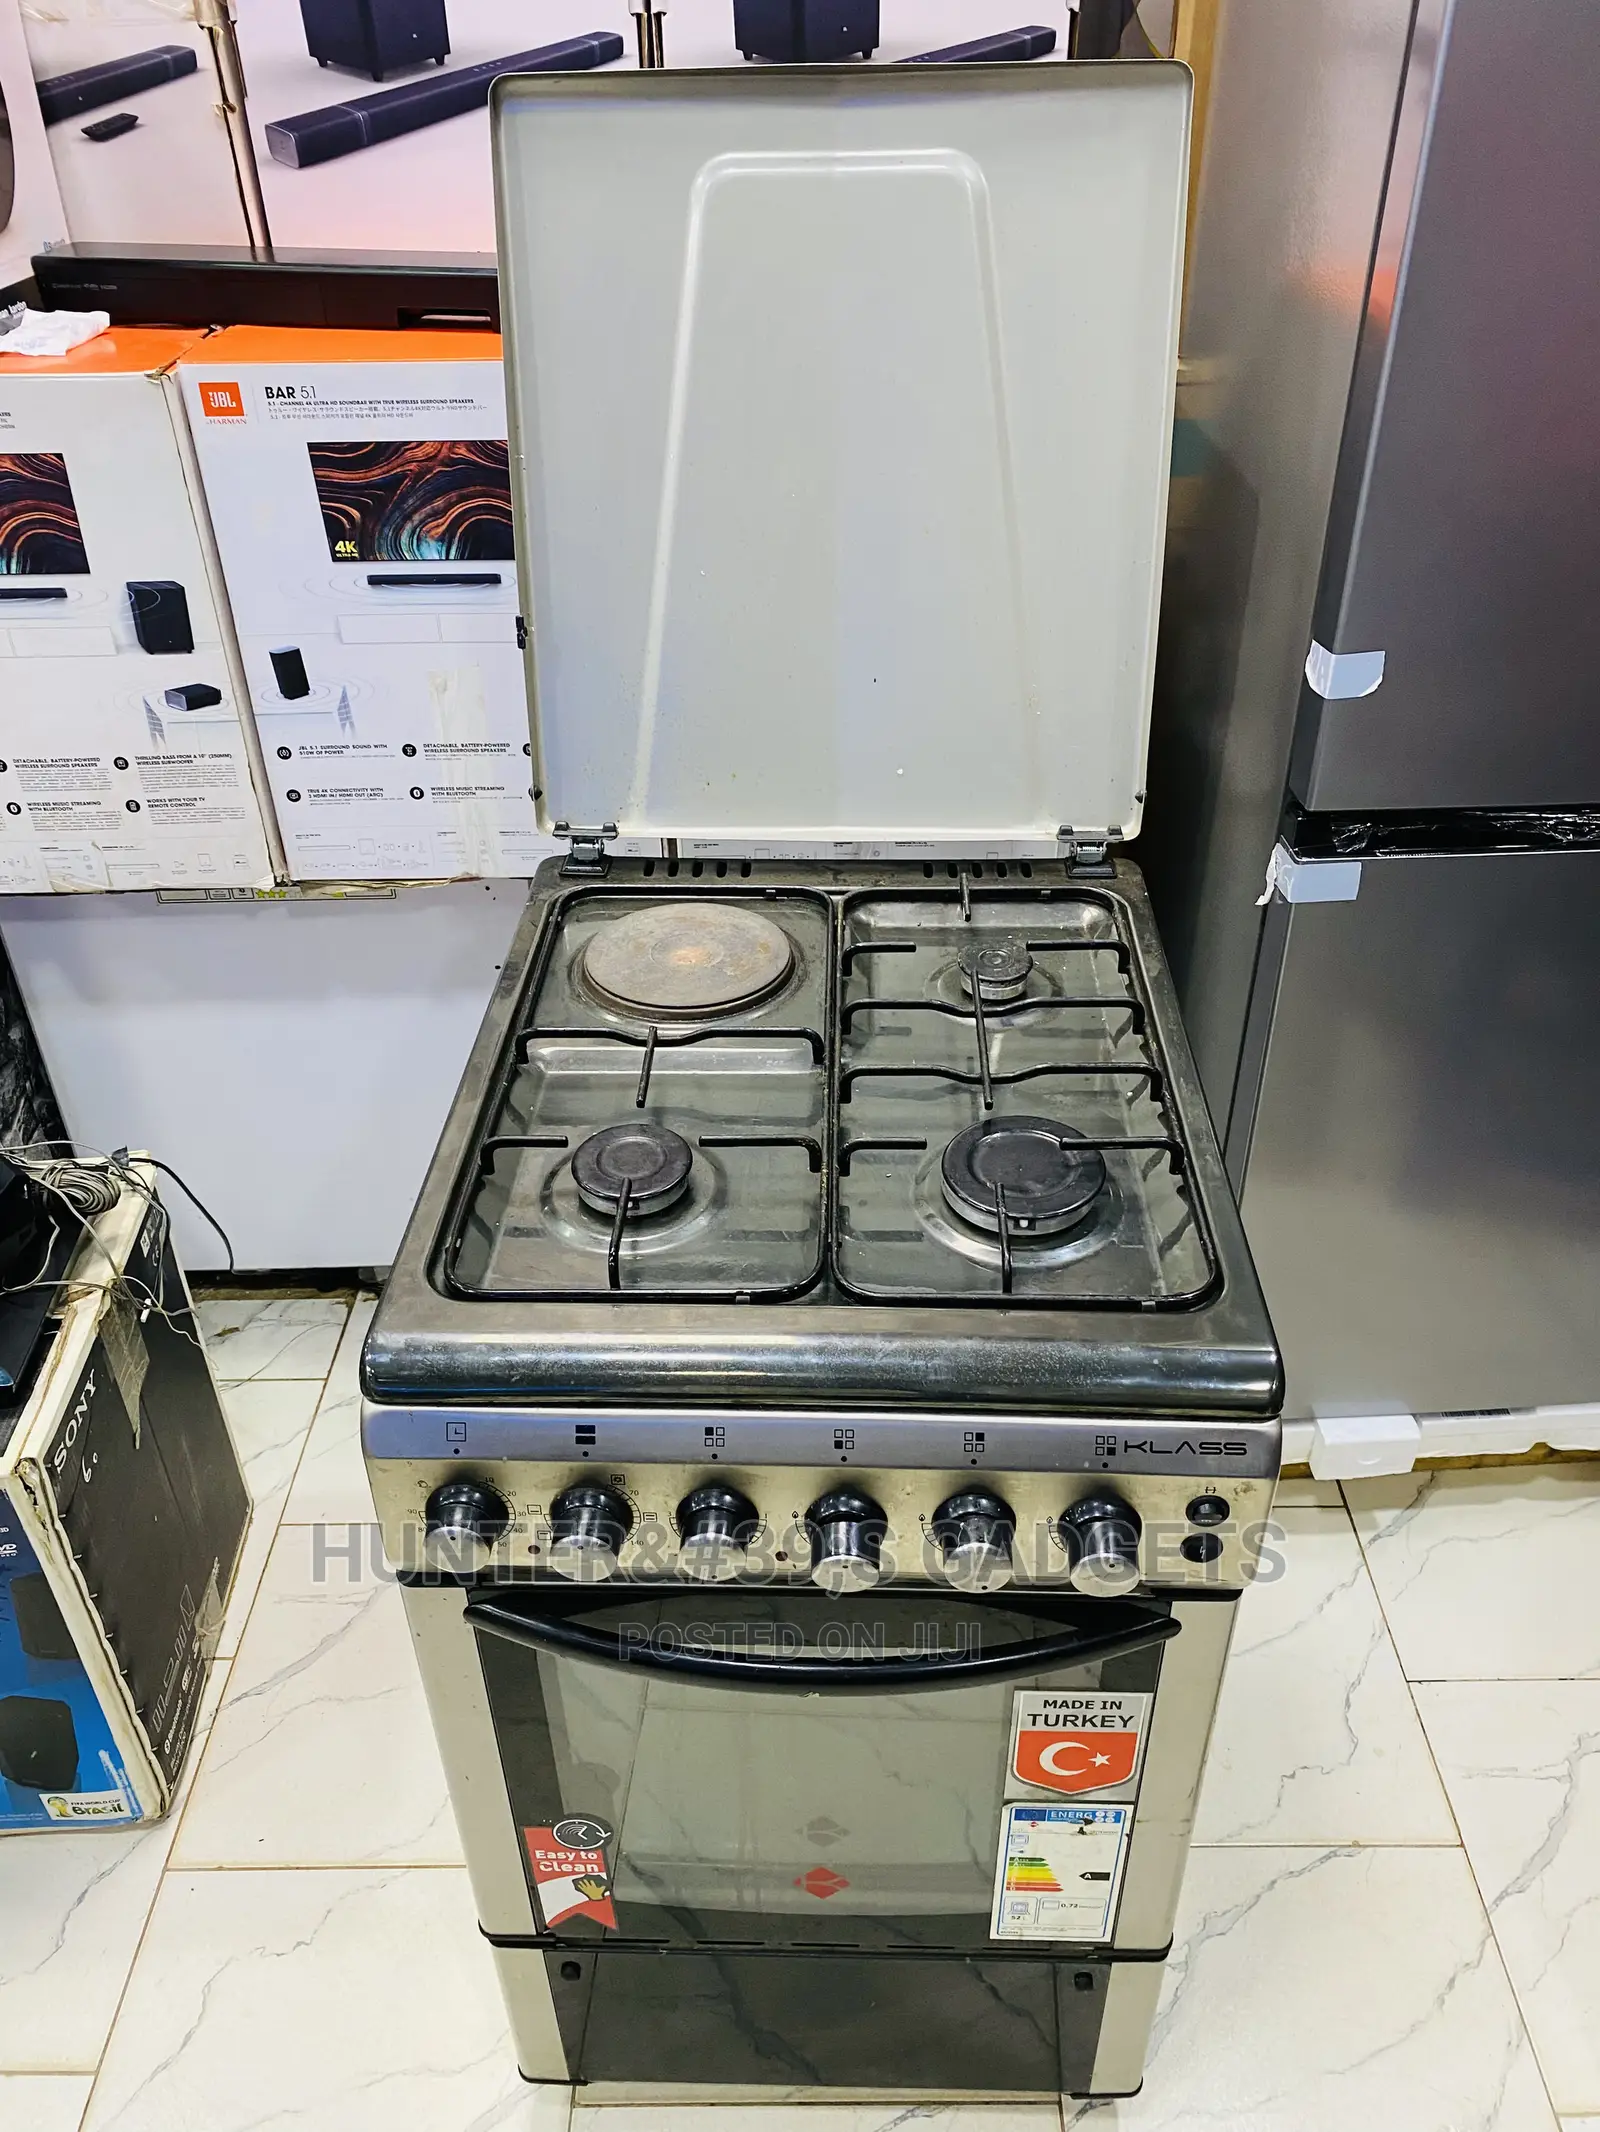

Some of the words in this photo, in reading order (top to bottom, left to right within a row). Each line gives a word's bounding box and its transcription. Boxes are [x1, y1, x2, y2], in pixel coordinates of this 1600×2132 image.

[264, 386, 296, 399] BAR
[300, 386, 316, 399] 5.1
[208, 392, 236, 408] JBL
[335, 540, 358, 552] 4K
[54, 1369, 96, 1474] SONY
[1124, 1440, 1248, 1456] KLASS
[1043, 1700, 1094, 1710] MADE
[1100, 1701, 1122, 1710] IN
[1027, 1714, 1134, 1728] TURKEY
[72, 1803, 124, 1815] Brasil
[1051, 1811, 1092, 1819] ENERG
[535, 1850, 575, 1861] Easy
[582, 1851, 598, 1859] to
[540, 1862, 598, 1872] Clean
